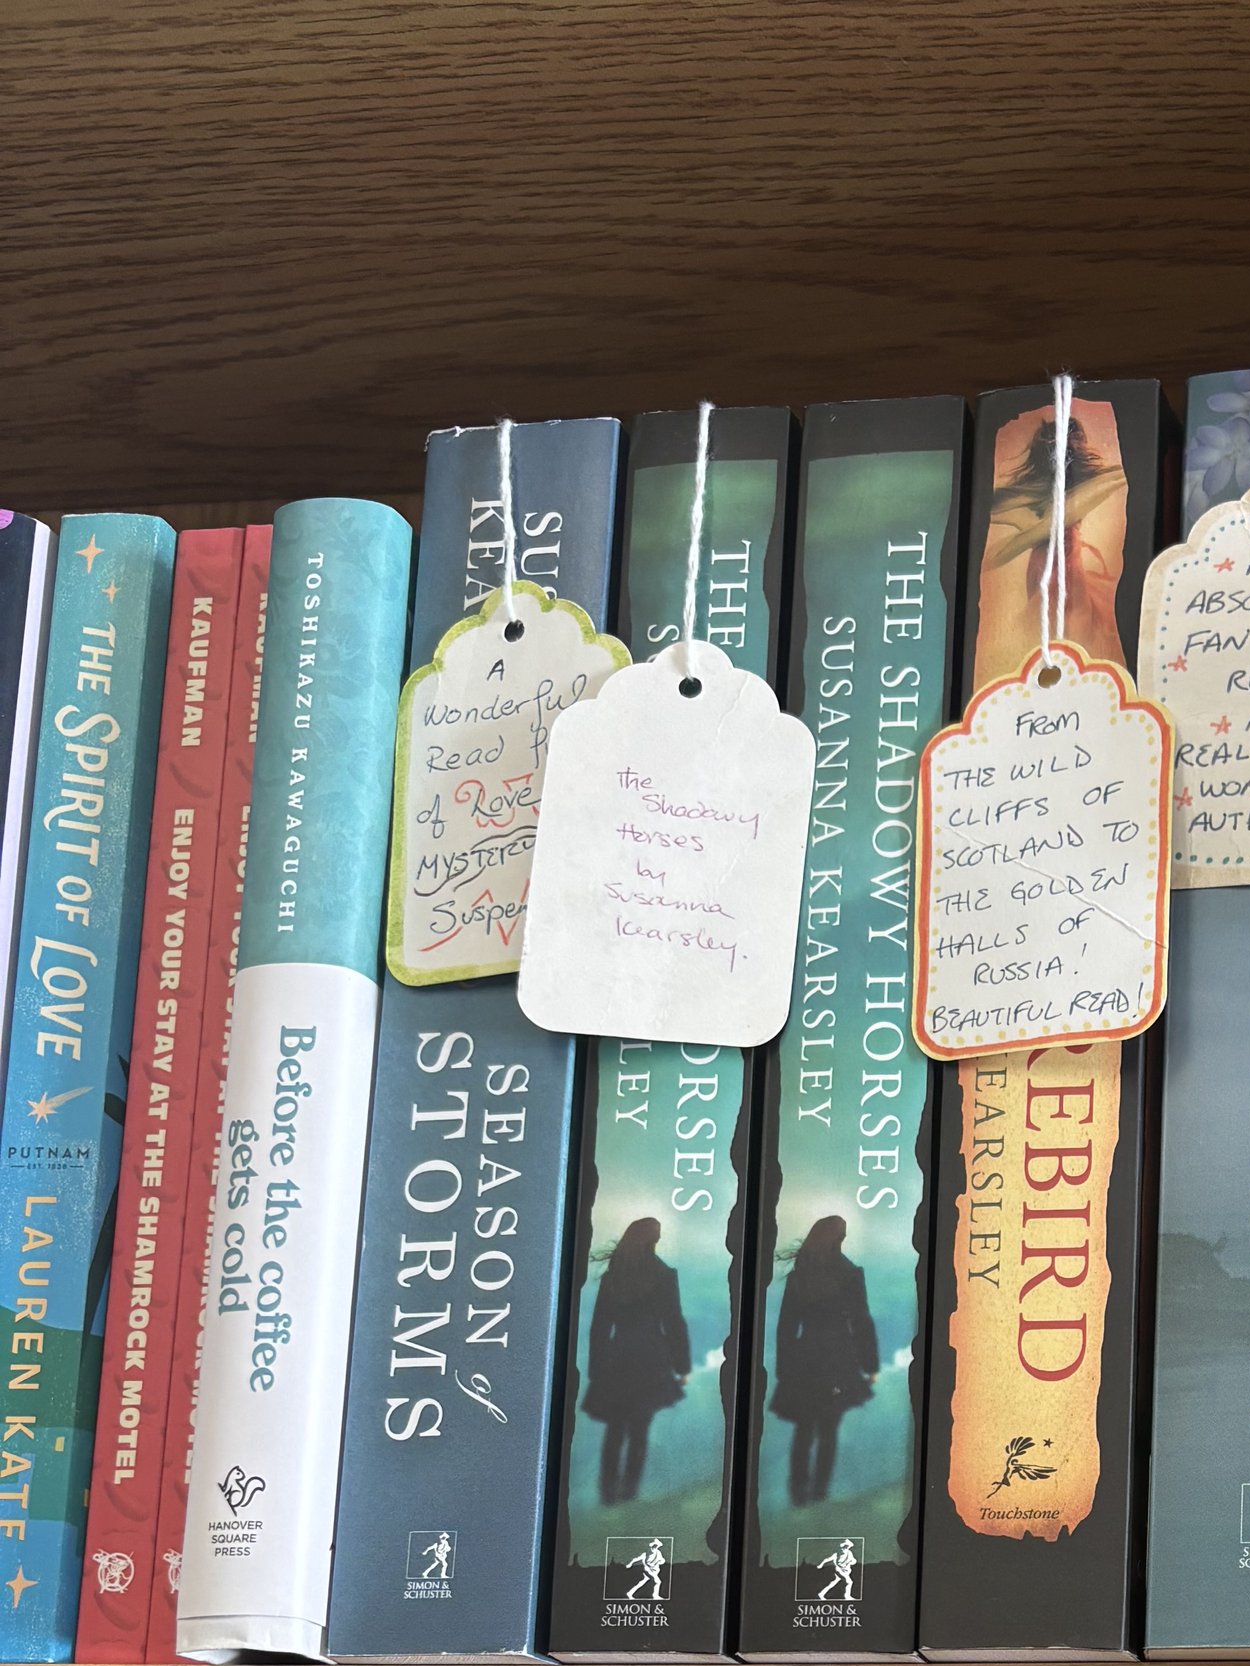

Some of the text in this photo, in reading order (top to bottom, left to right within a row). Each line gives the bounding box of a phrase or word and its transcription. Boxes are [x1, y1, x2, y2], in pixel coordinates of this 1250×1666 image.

[707, 540, 752, 650] THE
[487, 660, 504, 680] A
[278, 553, 324, 933] TOSHIKAZU KAWAGUCHI
[426, 735, 504, 774] Read
[944, 745, 1091, 791] THE WILD
[416, 795, 445, 839] of
[949, 780, 1125, 828] CLIFFS OF
[30, 623, 120, 1060] THE SPIRIT OF LOVE
[616, 824, 704, 851] Horses
[943, 820, 1139, 871] SCOTLAND TO
[636, 859, 665, 886] by
[799, 616, 857, 1128] SUSANNA KEARSLEY
[857, 531, 928, 1210] THE SHADOWY HORSES
[937, 863, 1129, 916] THE GOLDEN
[937, 908, 1095, 959] HALLS OF
[932, 982, 1143, 1033] BEAUTIFUL READ!
[114, 597, 213, 1484] KAUFMAN ENJOY YOUR STAY AT THE SHAMROCK MOTEL
[8, 1147, 90, 1159] PUTNAM
[218, 1119, 259, 1316] gets cold
[249, 1026, 316, 1392] Before the coffee
[465, 1063, 530, 1348] SEASON
[384, 1031, 475, 1442] STORMS
[9, 1197, 56, 1389] LAUREN
[209, 1521, 263, 1531] HANOVER
[980, 1508, 1061, 1521] Touchstone
[211, 1534, 257, 1543] SQUARE
[215, 1547, 251, 1557] PRESS
[404, 1590, 452, 1599] SCHUSTER
[606, 1604, 652, 1614] SIMON
[798, 1605, 843, 1615] SIMON
[601, 1616, 669, 1626] SCHUSTER
[793, 1617, 861, 1628] SCHUSTER
